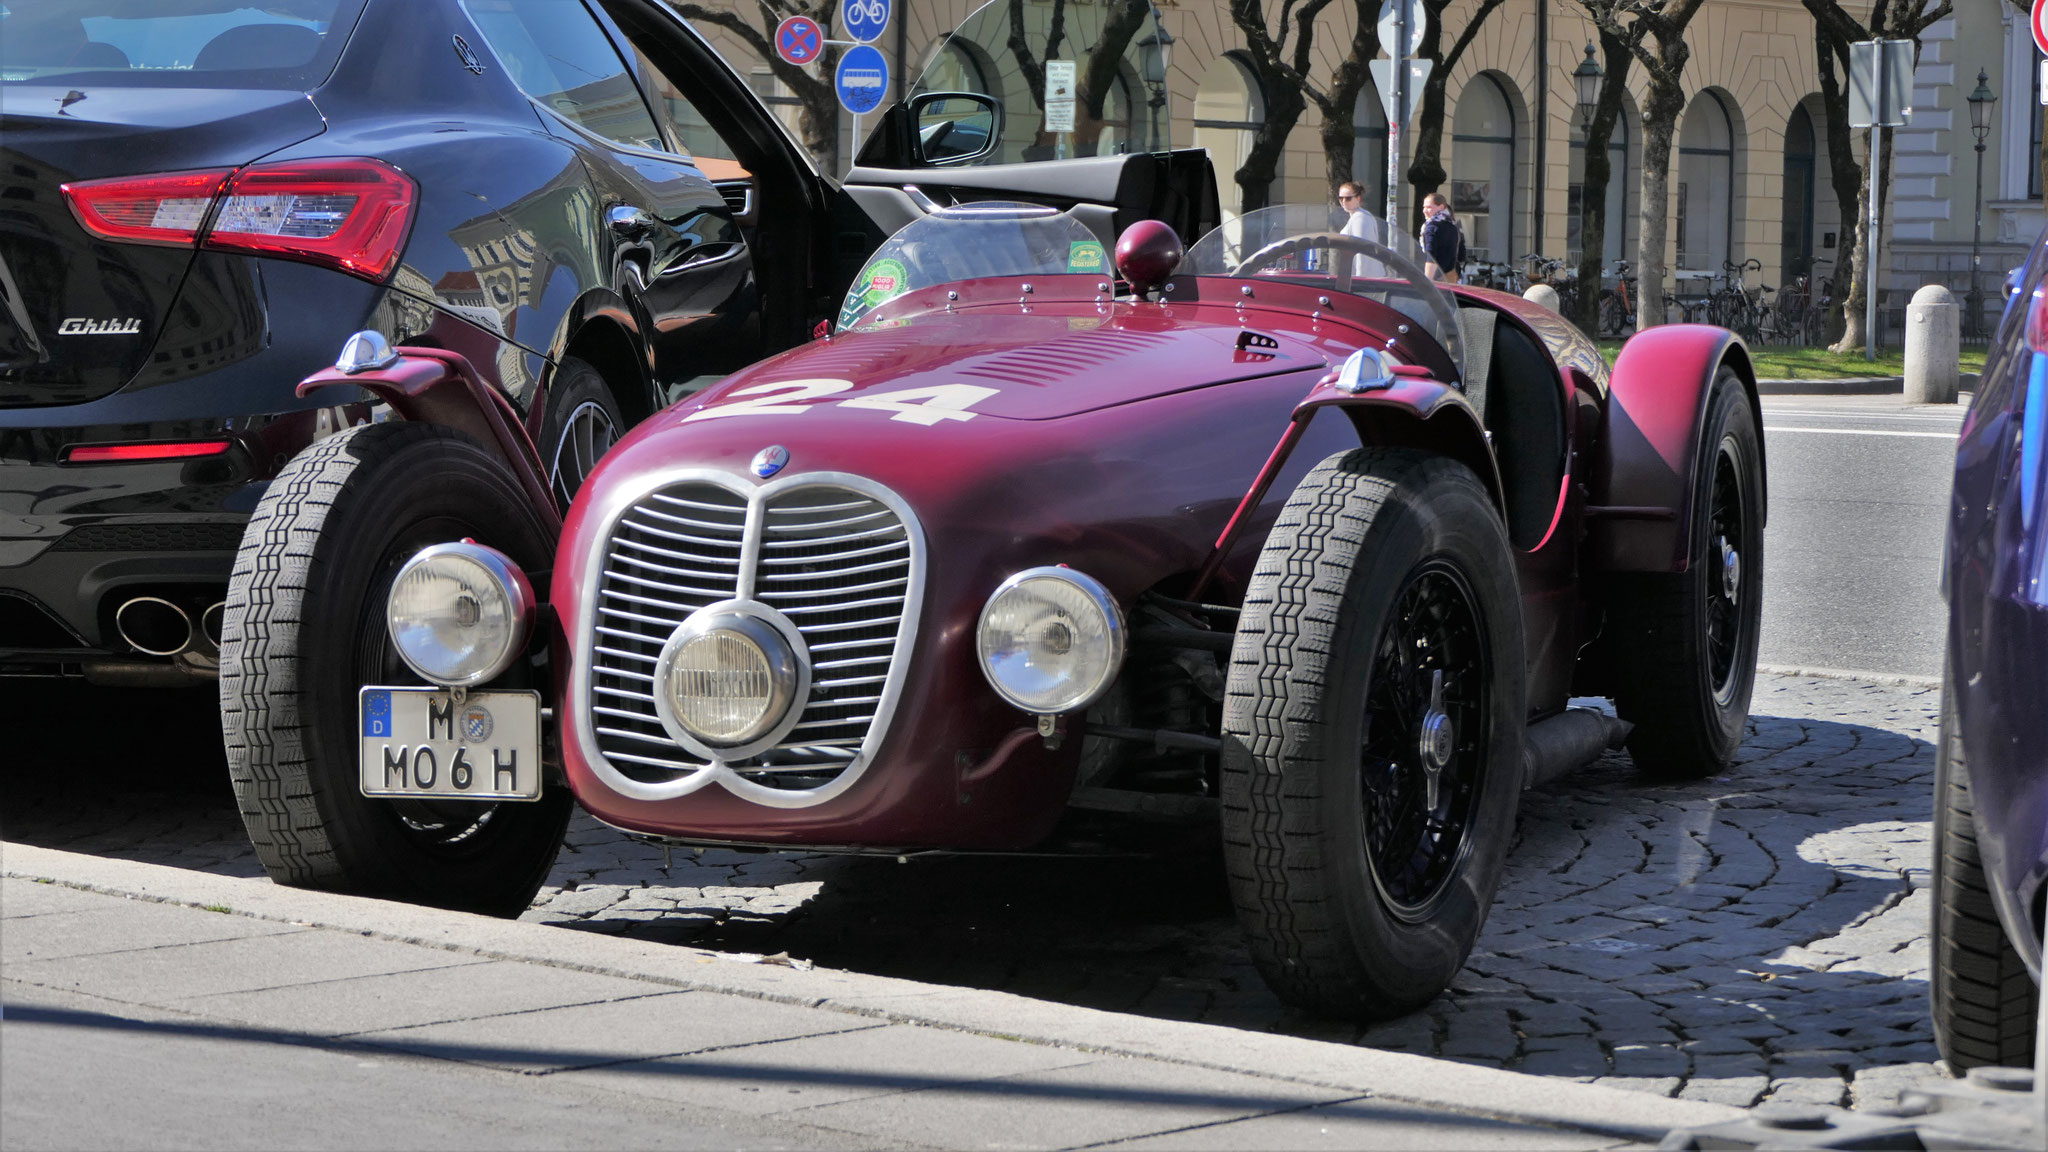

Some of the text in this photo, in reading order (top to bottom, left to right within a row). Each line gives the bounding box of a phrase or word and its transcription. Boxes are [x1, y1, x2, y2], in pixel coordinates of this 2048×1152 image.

[58, 317, 141, 335] Ghibli
[681, 378, 1001, 427] 24
[373, 720, 383, 734] D
[427, 697, 453, 740] M
